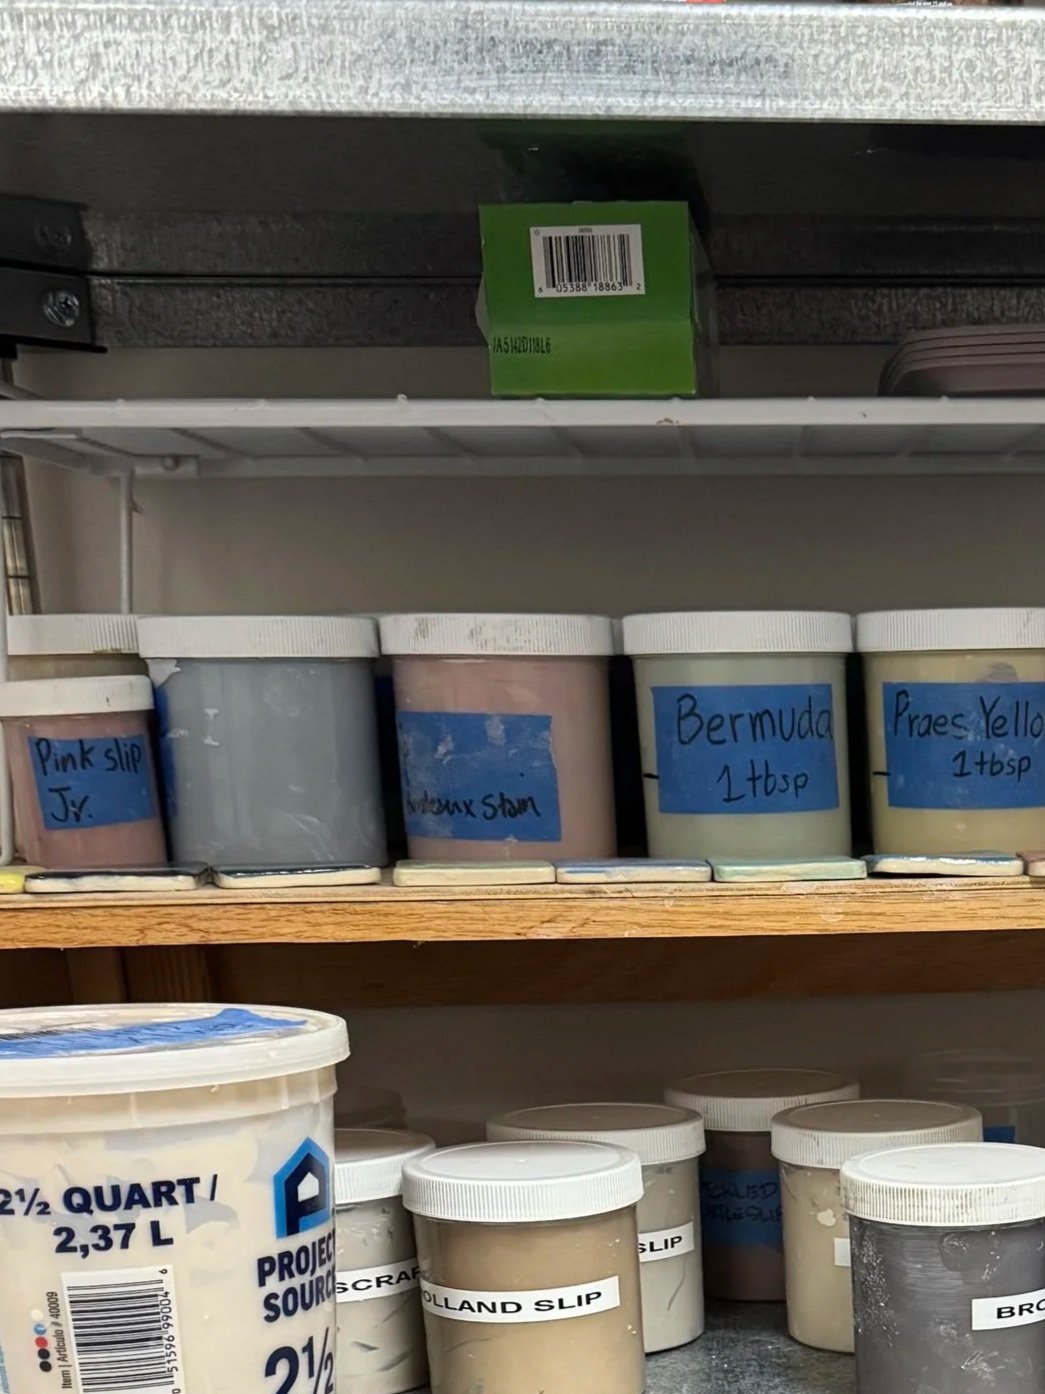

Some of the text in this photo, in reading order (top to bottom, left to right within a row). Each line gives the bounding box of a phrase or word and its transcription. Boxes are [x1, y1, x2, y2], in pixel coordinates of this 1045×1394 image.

[556, 282, 588, 293] 05388
[594, 280, 624, 291] 18863
[636, 283, 641, 291] 2
[677, 693, 835, 745] Bermuda
[894, 689, 970, 740] Praes
[35, 737, 142, 776] Pink slip
[951, 750, 1032, 783] 1 tbsp
[716, 759, 809, 804] 1 tbsp
[63, 1177, 201, 1216] QUART
[53, 1220, 174, 1259] 2,37 L
[46, 1291, 61, 1319] 40009
[159, 1291, 174, 1329] 99004
[534, 1291, 602, 1312] SLIP
[54, 1329, 69, 1363] Artículo
[165, 1334, 179, 1373] 51596
[61, 1370, 73, 1389] Item
